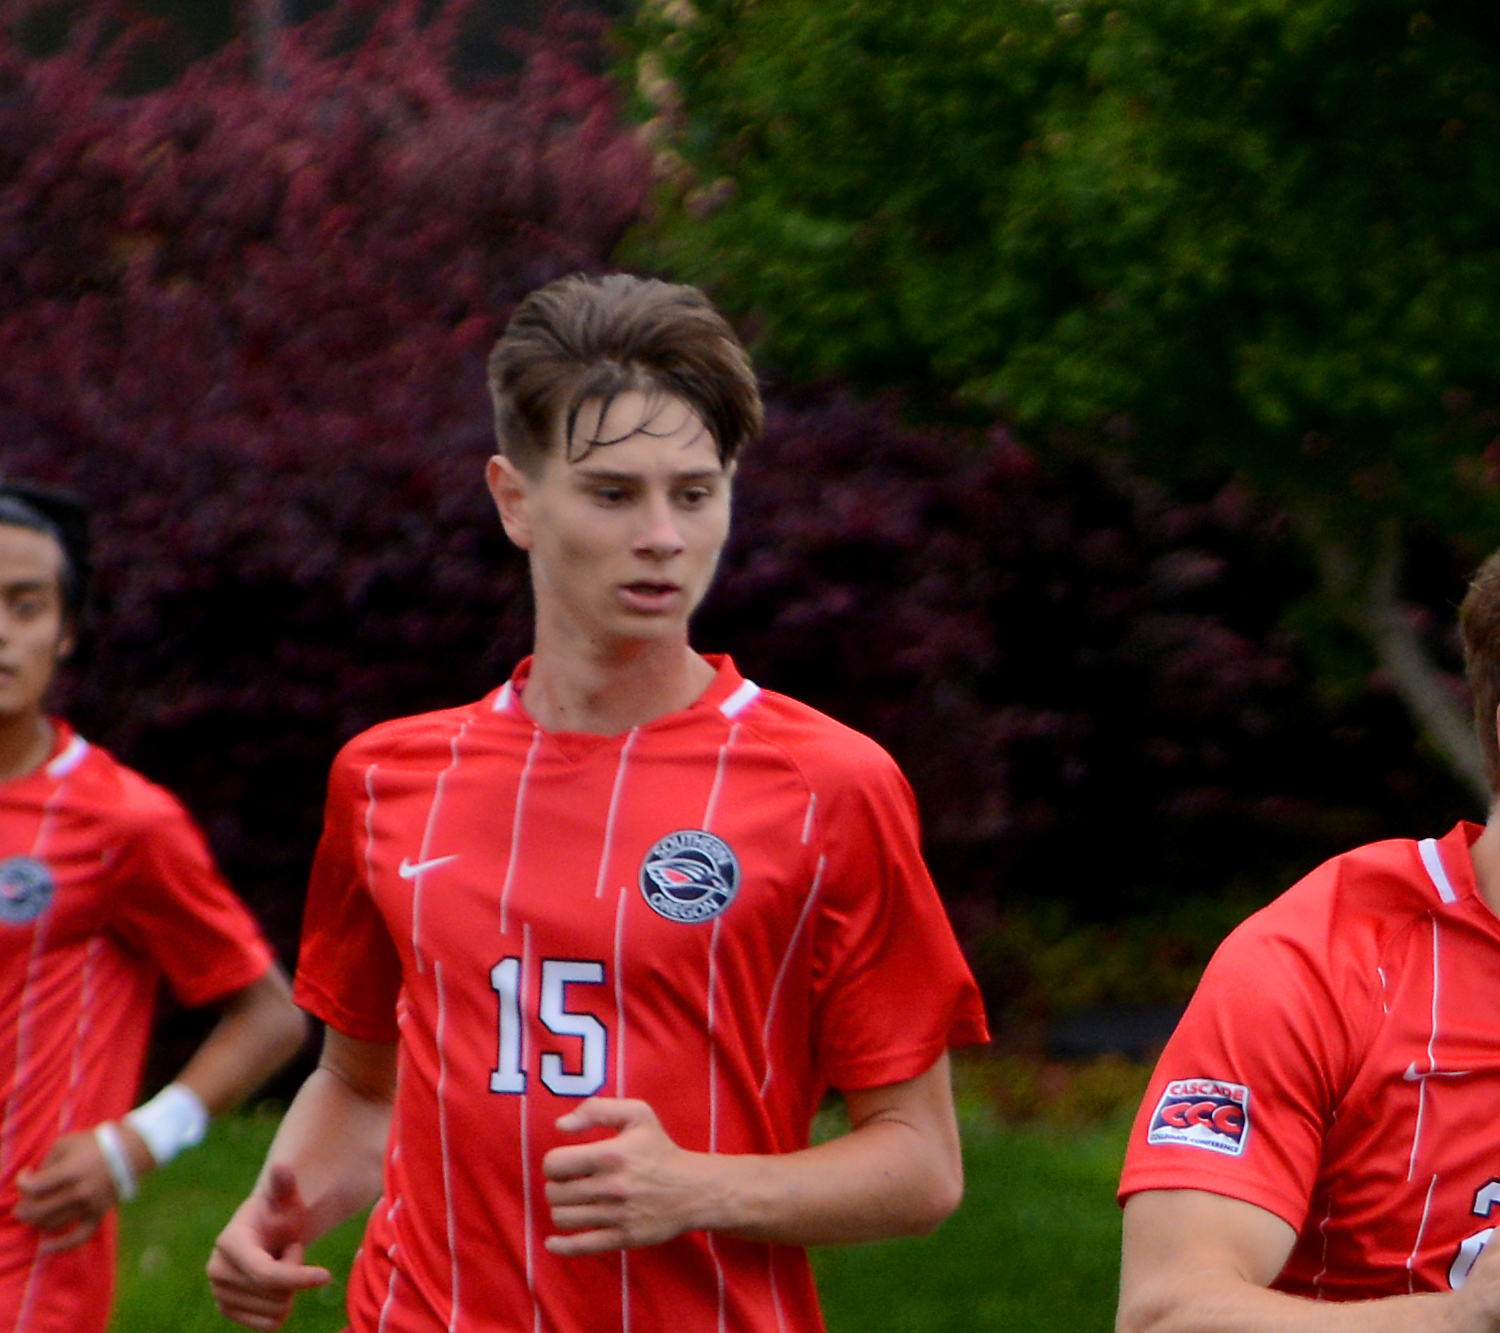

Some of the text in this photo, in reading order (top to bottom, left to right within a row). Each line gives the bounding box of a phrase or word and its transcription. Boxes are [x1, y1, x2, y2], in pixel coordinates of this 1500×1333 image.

[651, 892, 720, 920] OREGON
[489, 955, 607, 1098] 15
[1170, 1082, 1244, 1101] CASCADE
[1161, 1101, 1242, 1133] CCC
